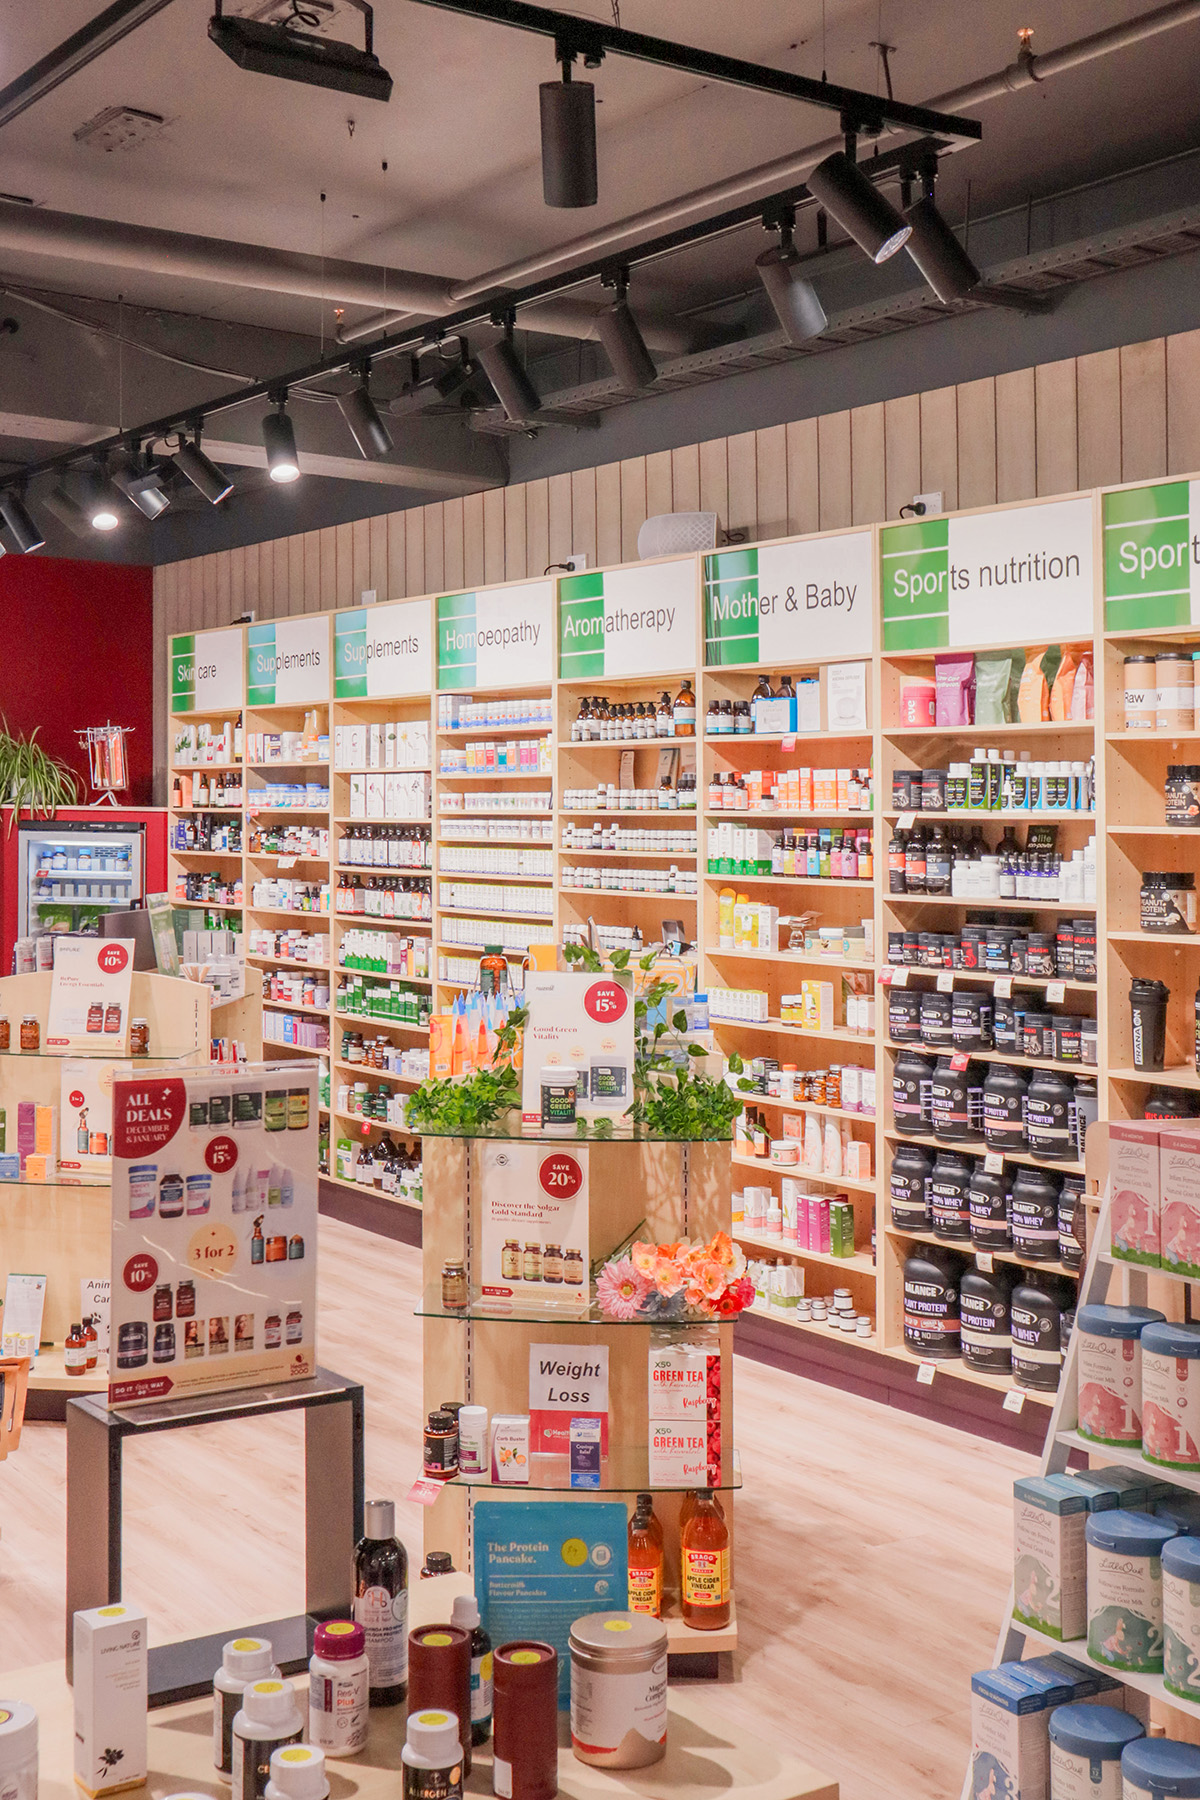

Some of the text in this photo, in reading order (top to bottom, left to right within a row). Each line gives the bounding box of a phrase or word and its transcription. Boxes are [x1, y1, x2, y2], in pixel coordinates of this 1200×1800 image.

[894, 550, 1081, 603] Sports nutrition
[713, 580, 858, 622] Mother & Baby
[563, 605, 676, 639] Aromatherapy
[445, 619, 541, 652] Homoeopathy
[344, 634, 419, 668] Supplements
[256, 648, 321, 679] Supplements
[177, 662, 217, 683] Skin care
[1124, 692, 1145, 703] Raw
[1074, 936, 1097, 944] MUSAS
[104, 956, 122, 967] 10%
[595, 999, 617, 1012] 15%
[126, 1093, 152, 1108] ALL
[126, 1107, 172, 1123] DEALS
[126, 1124, 170, 1135] DECEMBER
[133, 1134, 167, 1143] JANUARY
[548, 1172, 576, 1186] 20%
[491, 1201, 560, 1212] Discover the Solgar
[944, 1197, 963, 1207] WHEY
[510, 1210, 543, 1218] Standard
[975, 1205, 992, 1216] WHEY
[1024, 1215, 1044, 1226] WHEY
[193, 1244, 235, 1260] 3 for 2
[87, 1280, 111, 1289] Anim
[904, 1281, 937, 1297] BALANCE
[93, 1294, 111, 1304] Car
[918, 1301, 948, 1312] PROTEIN
[968, 1314, 995, 1328] PROTEIN
[1011, 1308, 1031, 1325] LANCE
[1017, 1327, 1040, 1343] WHEY
[539, 1360, 601, 1379] Weight
[653, 1370, 704, 1382] GREEN TEA
[547, 1387, 590, 1403] Loss
[682, 1394, 717, 1408] Raspberry
[1120, 1404, 1137, 1433] 1
[653, 1436, 704, 1448] GREEN TEA
[1174, 1425, 1192, 1456] 1
[683, 1461, 717, 1475] Raspberry
[487, 1541, 549, 1552] The Protein
[488, 1553, 537, 1564] Pancake.
[690, 1553, 714, 1561] BRAGG
[687, 1575, 702, 1583] APPLE
[1147, 1627, 1164, 1657] 2
